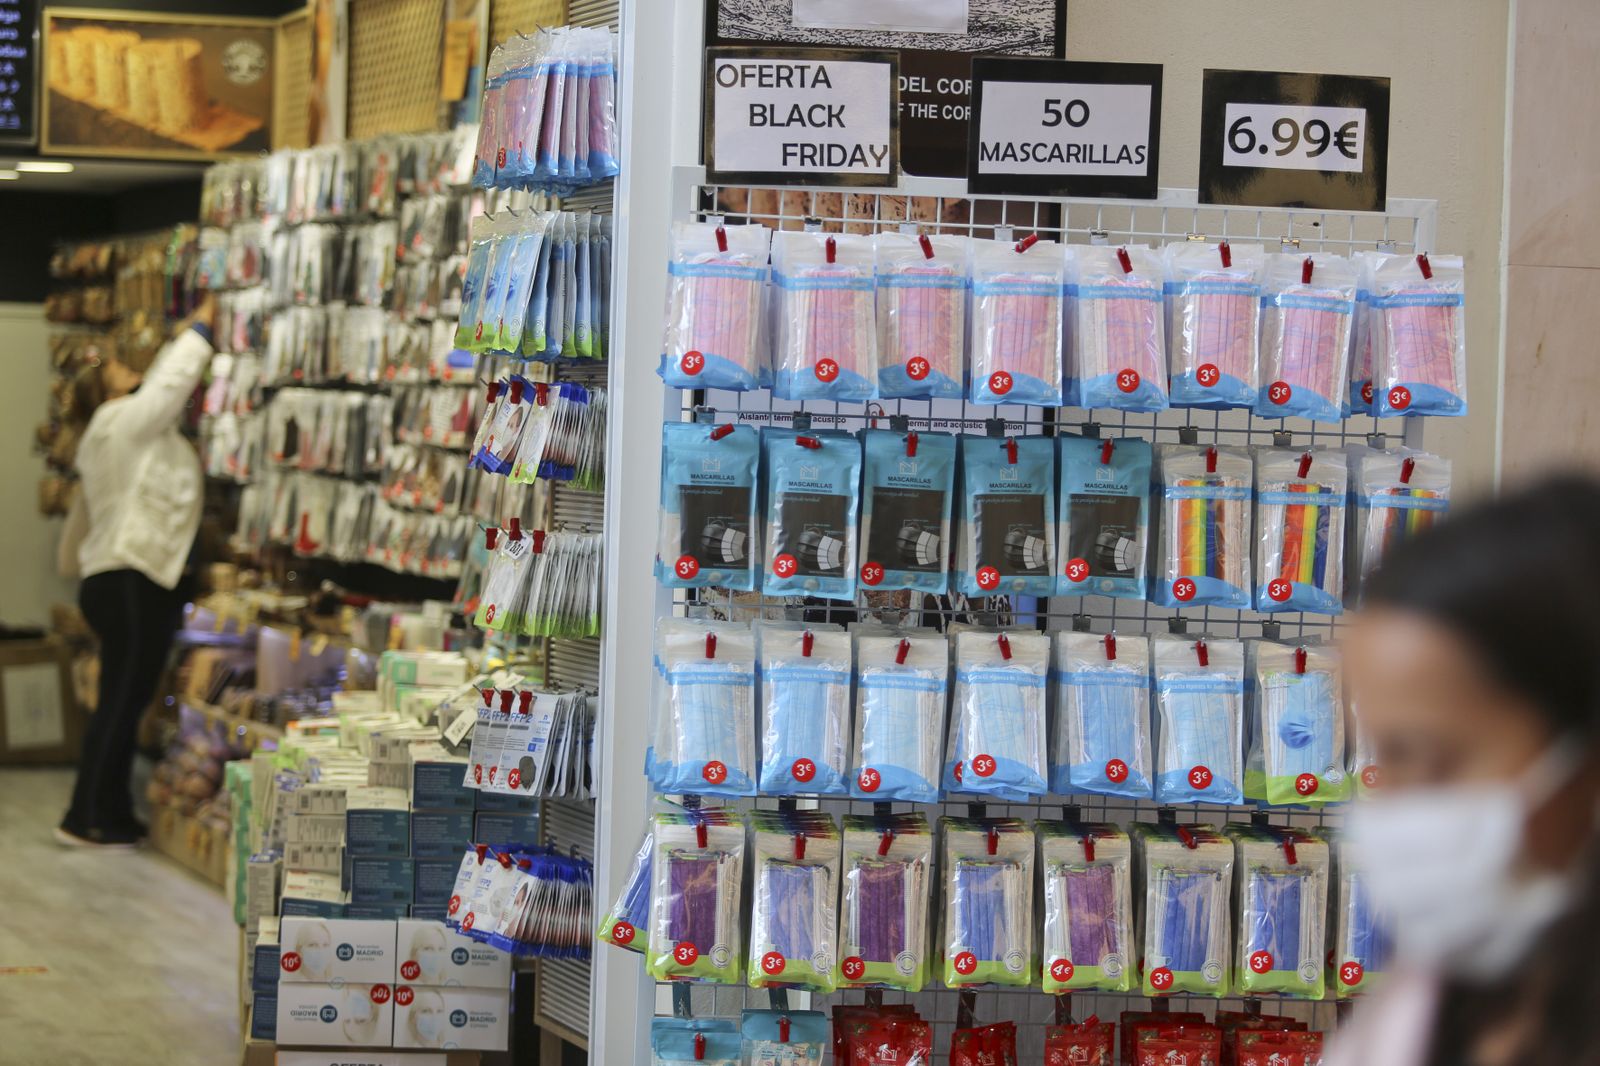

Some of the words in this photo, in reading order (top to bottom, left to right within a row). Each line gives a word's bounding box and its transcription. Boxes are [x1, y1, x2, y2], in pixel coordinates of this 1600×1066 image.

[716, 64, 832, 89] OFERTA
[898, 76, 932, 93] DEL
[749, 103, 846, 128] BLACK
[908, 103, 938, 119] THE
[1041, 98, 1090, 127] 50
[1227, 115, 1358, 159] 6.99€
[782, 143, 888, 168] FRIDAY
[979, 141, 1146, 165] MASCARILLAS
[685, 356, 701, 369] 3€
[911, 361, 925, 375] 3€
[819, 363, 835, 376] 3€
[1201, 369, 1215, 382] 3€
[993, 376, 1009, 389] 3€
[1122, 374, 1136, 387] 3€
[1273, 387, 1287, 400] 3€
[1365, 385, 1373, 398] 3
[1392, 392, 1407, 405] 3€
[933, 420, 948, 428] and
[788, 481, 832, 489] MASCARILLAS
[887, 476, 932, 484] MASCARILLAS
[1084, 482, 1128, 490] MASCARILLAS
[680, 561, 695, 575] 3€
[778, 560, 793, 573] 3€
[1070, 564, 1085, 577] 3€
[865, 568, 880, 580] 3€
[980, 572, 996, 585] 3€
[1177, 583, 1192, 597] 3€
[1273, 583, 1288, 597] 3€
[511, 711, 533, 723] FFP2
[708, 765, 723, 780] 3€
[797, 764, 812, 777] 3€
[977, 760, 992, 773] 3€
[1110, 765, 1124, 778] 3€
[510, 773, 519, 785] 2€
[862, 772, 877, 786] 3€
[1193, 772, 1208, 785] 3€
[1300, 779, 1314, 792] 3€
[616, 927, 631, 939] 3€
[679, 948, 694, 961] 3€
[766, 957, 781, 970] 3€
[847, 962, 861, 975] 3€
[957, 957, 973, 970] 4€
[1254, 956, 1268, 969] 3€
[1054, 965, 1070, 976] 4€
[1344, 967, 1359, 980] 3€
[1154, 973, 1169, 986] 3€
